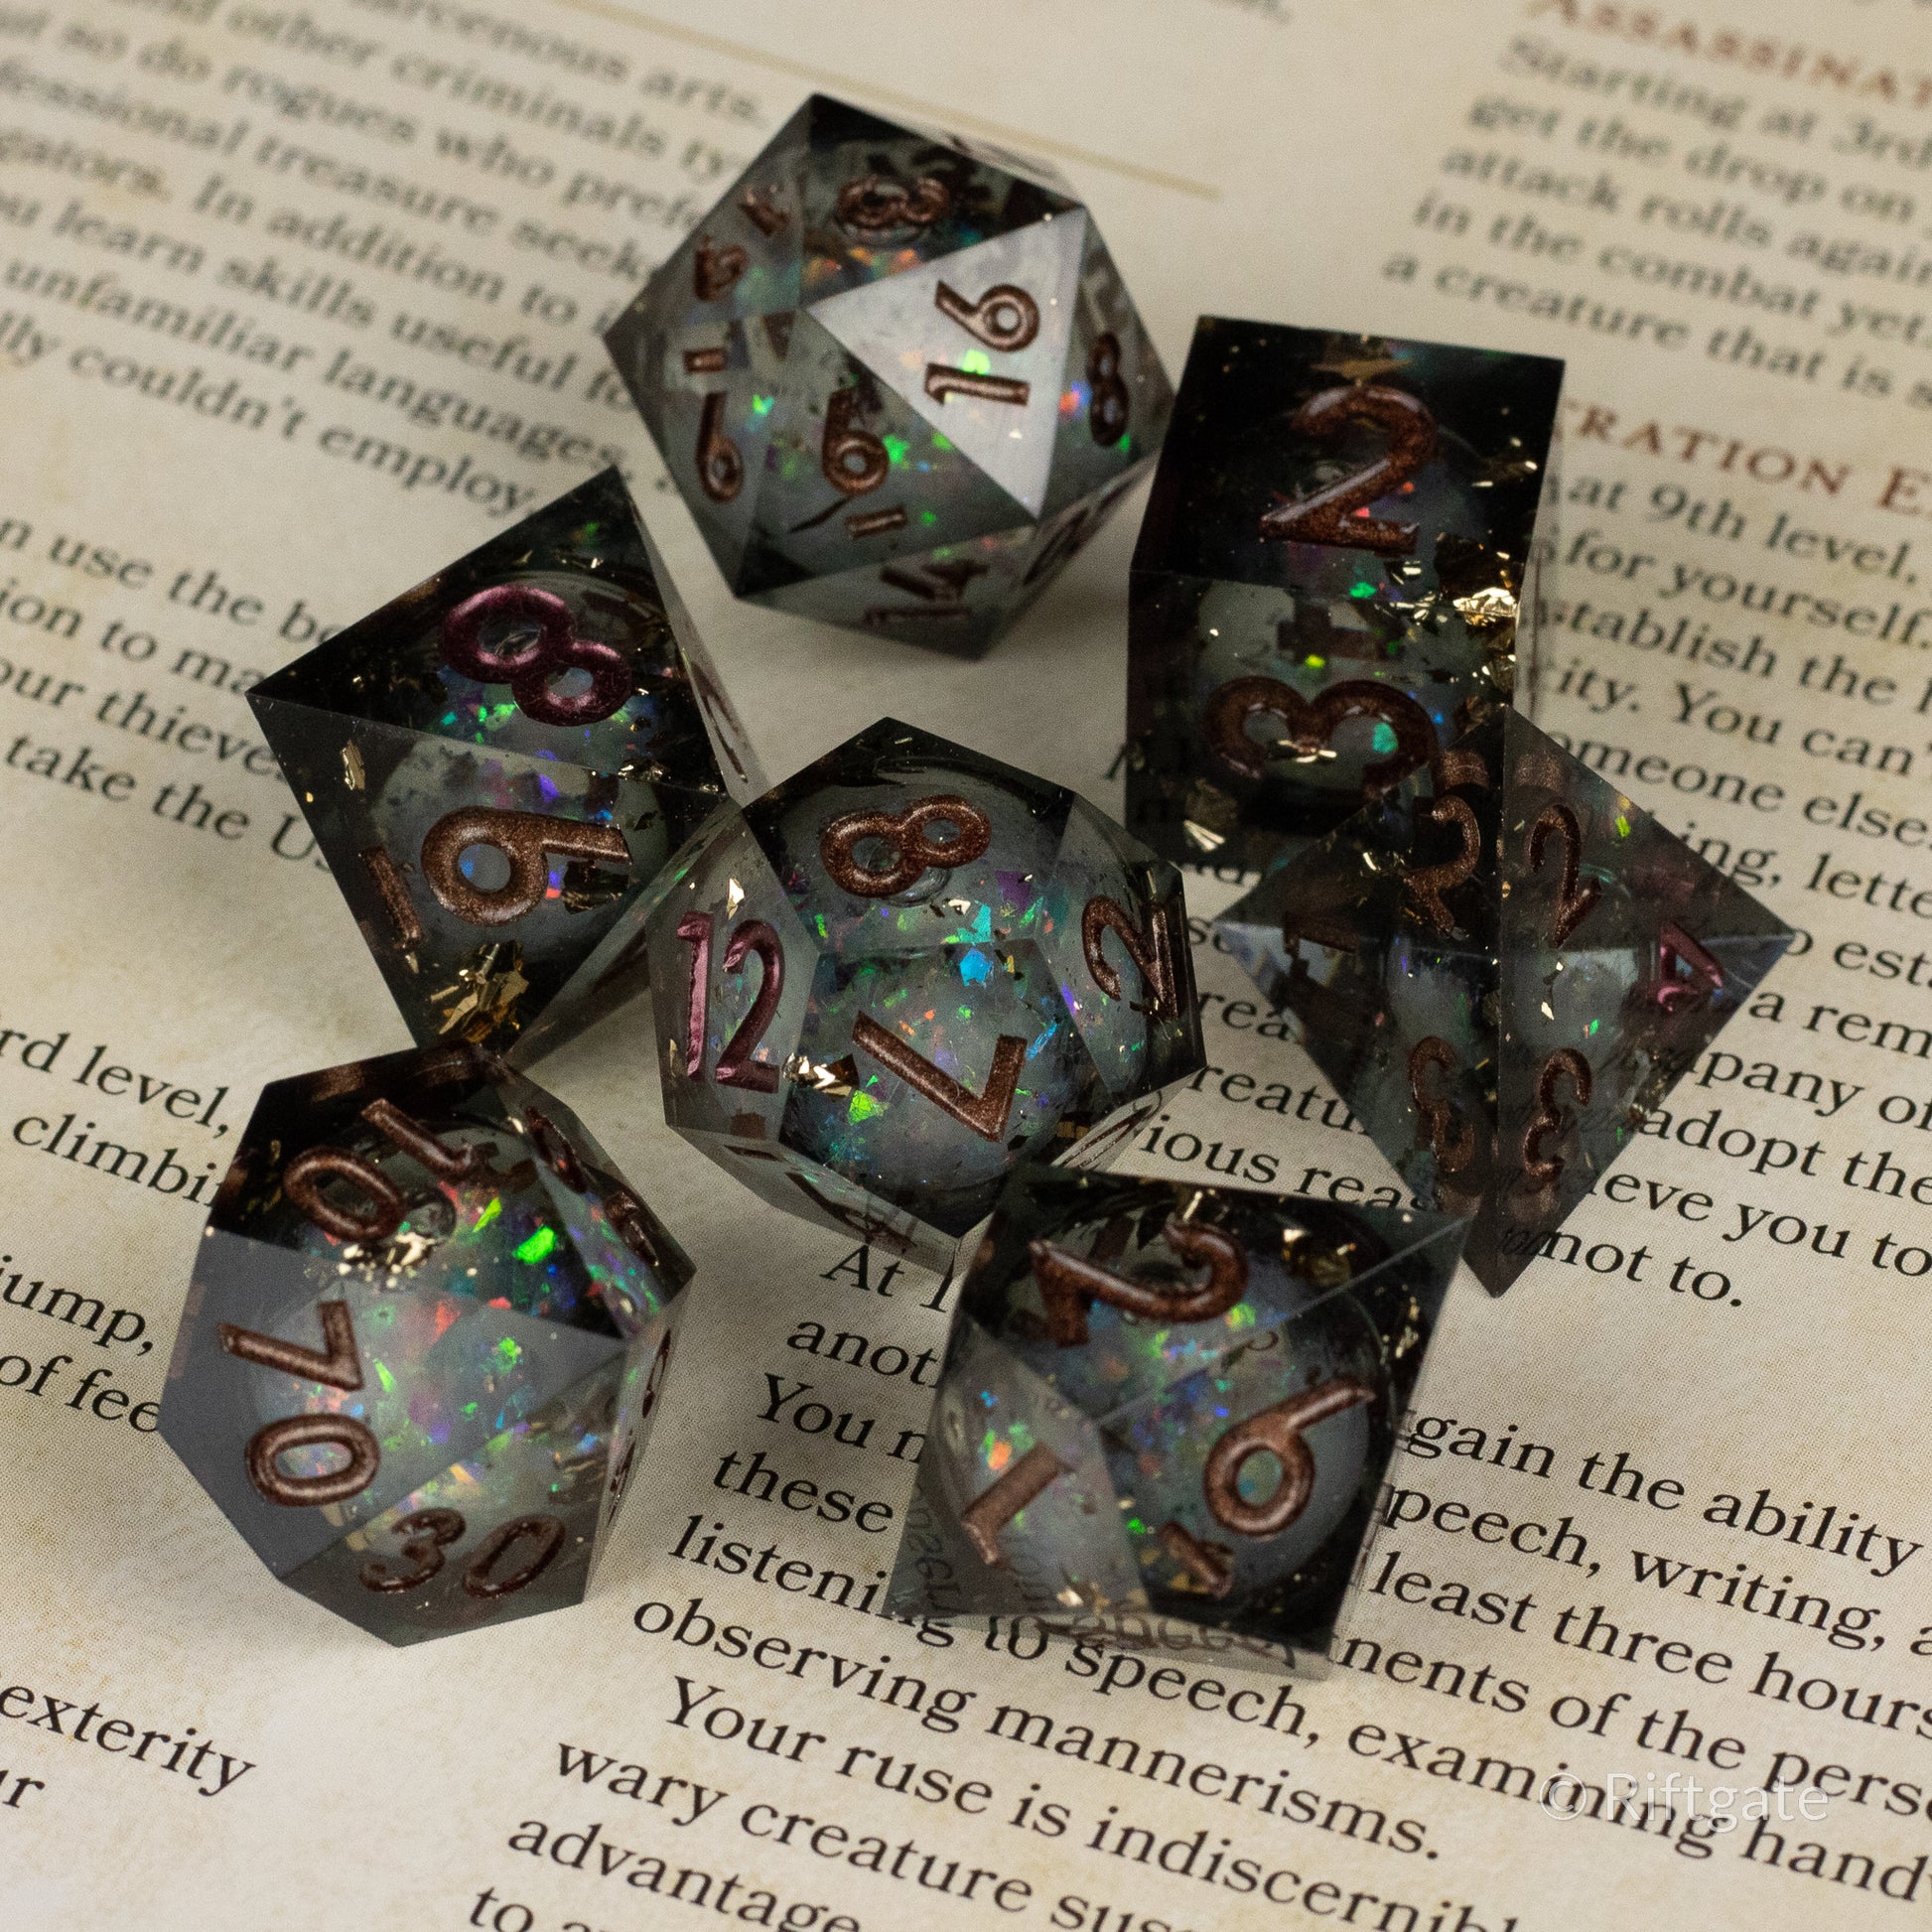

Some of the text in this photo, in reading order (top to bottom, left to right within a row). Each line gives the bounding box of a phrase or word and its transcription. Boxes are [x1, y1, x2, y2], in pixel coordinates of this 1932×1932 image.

[1440, 146, 1621, 216] attack
[1636, 194, 1773, 250] rolls
[215, 254, 376, 332] skills
[1413, 189, 1472, 236] in
[1487, 212, 1585, 267] the
[1594, 241, 1822, 324] combat
[2, 256, 317, 375] unfamiliar
[923, 279, 1041, 408] 16
[1381, 249, 1421, 286] a
[1432, 260, 1692, 353] creature
[1705, 322, 1830, 384] that
[1841, 353, 1895, 400] is
[1258, 384, 1440, 556] 2
[48, 528, 154, 590] use
[167, 567, 266, 627] the
[1646, 483, 1747, 542] 9th
[1766, 512, 1918, 589] level,
[98, 617, 160, 664] to
[443, 583, 633, 727] 8
[1798, 652, 1898, 708] the
[1672, 680, 1782, 747] You
[3, 730, 251, 842] take the
[819, 793, 992, 898] 8
[675, 910, 781, 1093] 12
[1747, 990, 1786, 1025] a
[72, 1043, 230, 1140] level,
[851, 1009, 1029, 1143] 7
[1689, 1048, 1867, 1119] pany
[1638, 1107, 1827, 1178] adopt
[1588, 1172, 1716, 1222] eve
[1722, 1201, 1852, 1260] you
[818, 1242, 905, 1299] At
[1668, 1255, 1743, 1309] to.
[786, 1319, 941, 1390] anot
[757, 1371, 877, 1450] You
[712, 1449, 894, 1534] these
[1578, 1450, 1687, 1512] the
[1702, 1487, 1926, 1579] ability
[358, 1505, 567, 1598] 30
[1631, 1548, 1887, 1654] writing,
[1374, 1549, 1540, 1635] least
[1551, 1604, 1735, 1685] three
[631, 1597, 1441, 1862] observing mannerisms.
[665, 1674, 828, 1765] Your
[834, 1744, 994, 1816] ruse
[1008, 1782, 1073, 1840] is
[1549, 1692, 1633, 1739] of
[1635, 1709, 1747, 1771] the
[556, 1741, 731, 1828] wary
[740, 1801, 1034, 1914] creature
[1346, 1721, 1729, 1861] examining
[1739, 1813, 1932, 1904] hand
